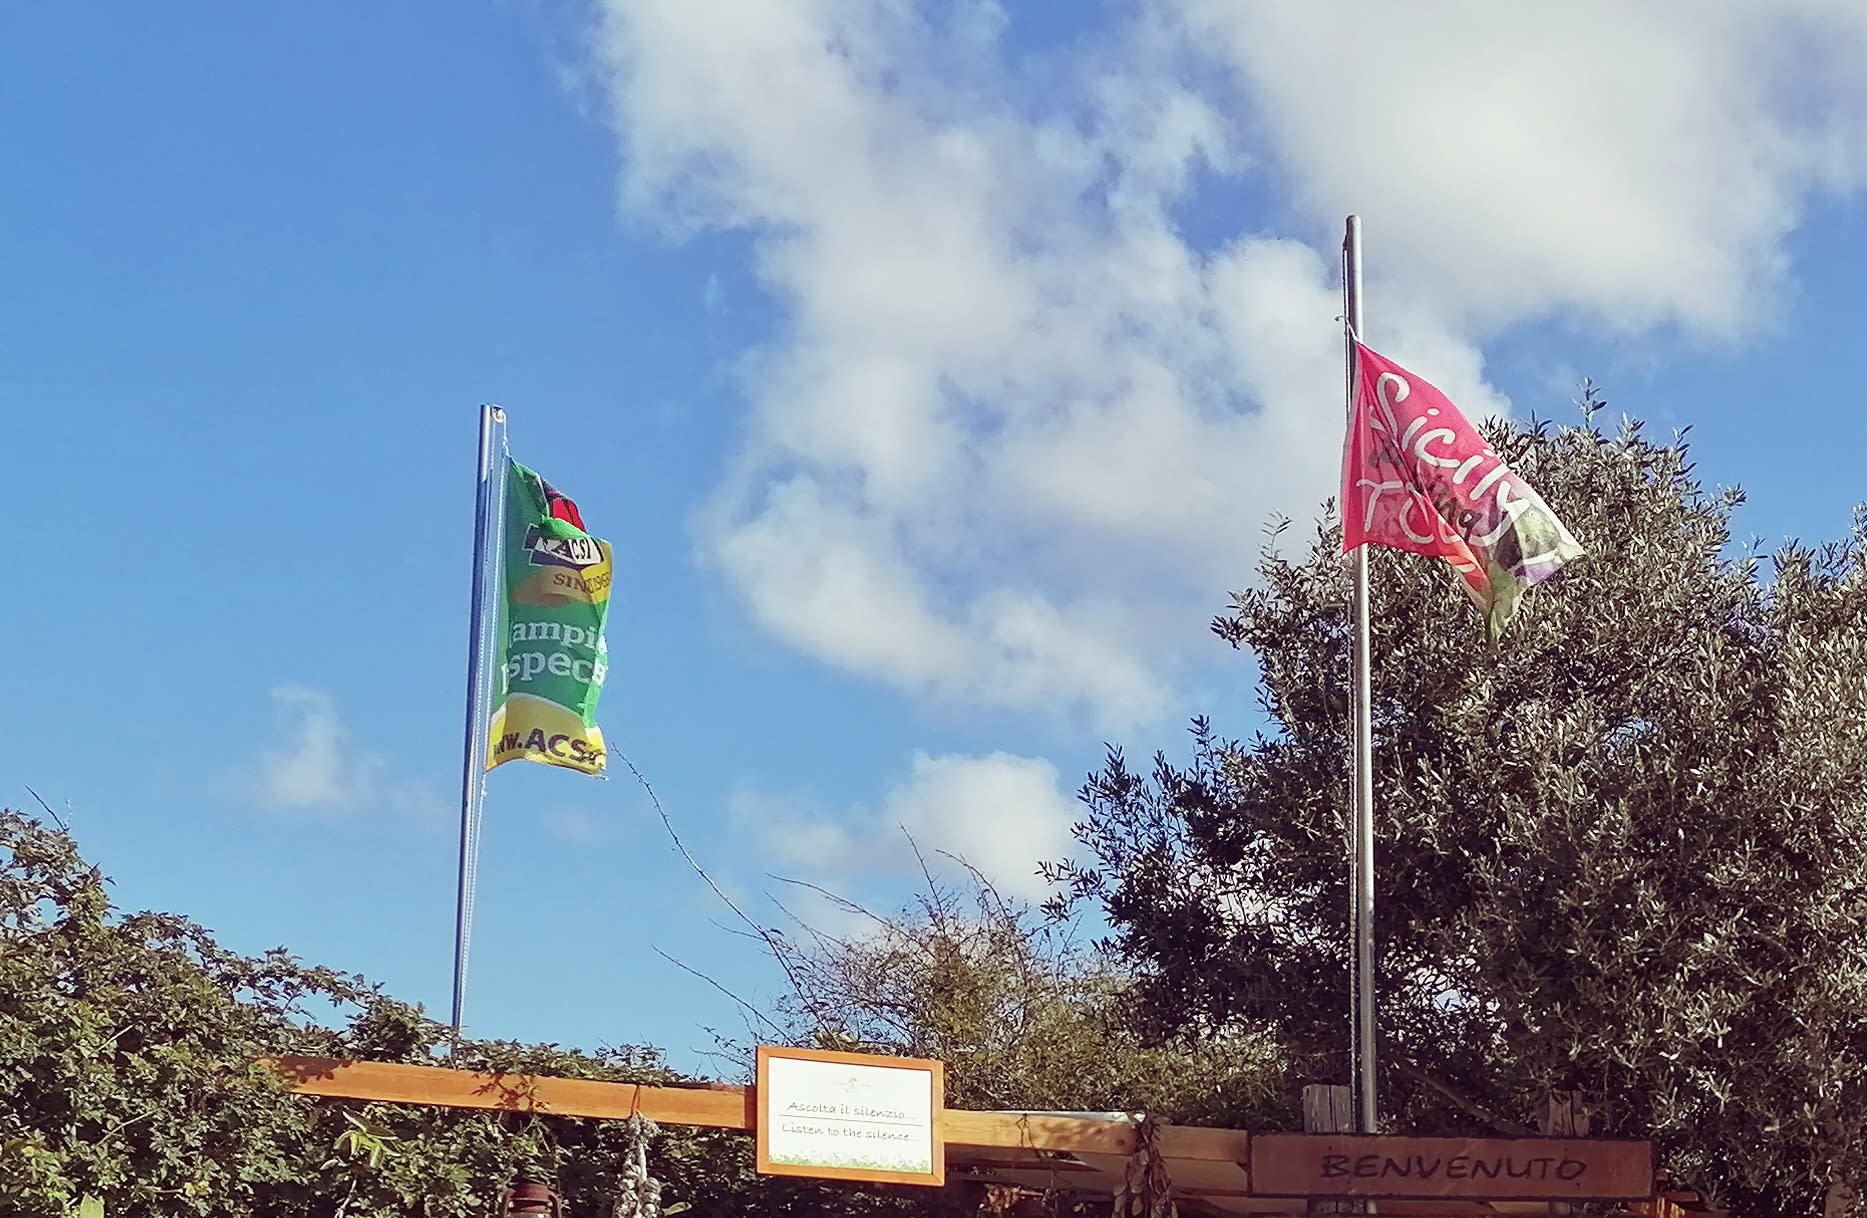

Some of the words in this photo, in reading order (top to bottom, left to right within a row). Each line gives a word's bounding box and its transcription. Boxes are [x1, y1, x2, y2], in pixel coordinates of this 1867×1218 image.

[787, 1102, 836, 1114] Ascolta
[840, 1104, 850, 1114] il
[782, 1122, 824, 1135] Listen
[828, 1127, 840, 1136] to
[843, 1127, 862, 1138] the
[1320, 1154, 1587, 1181] BENVENUTO
